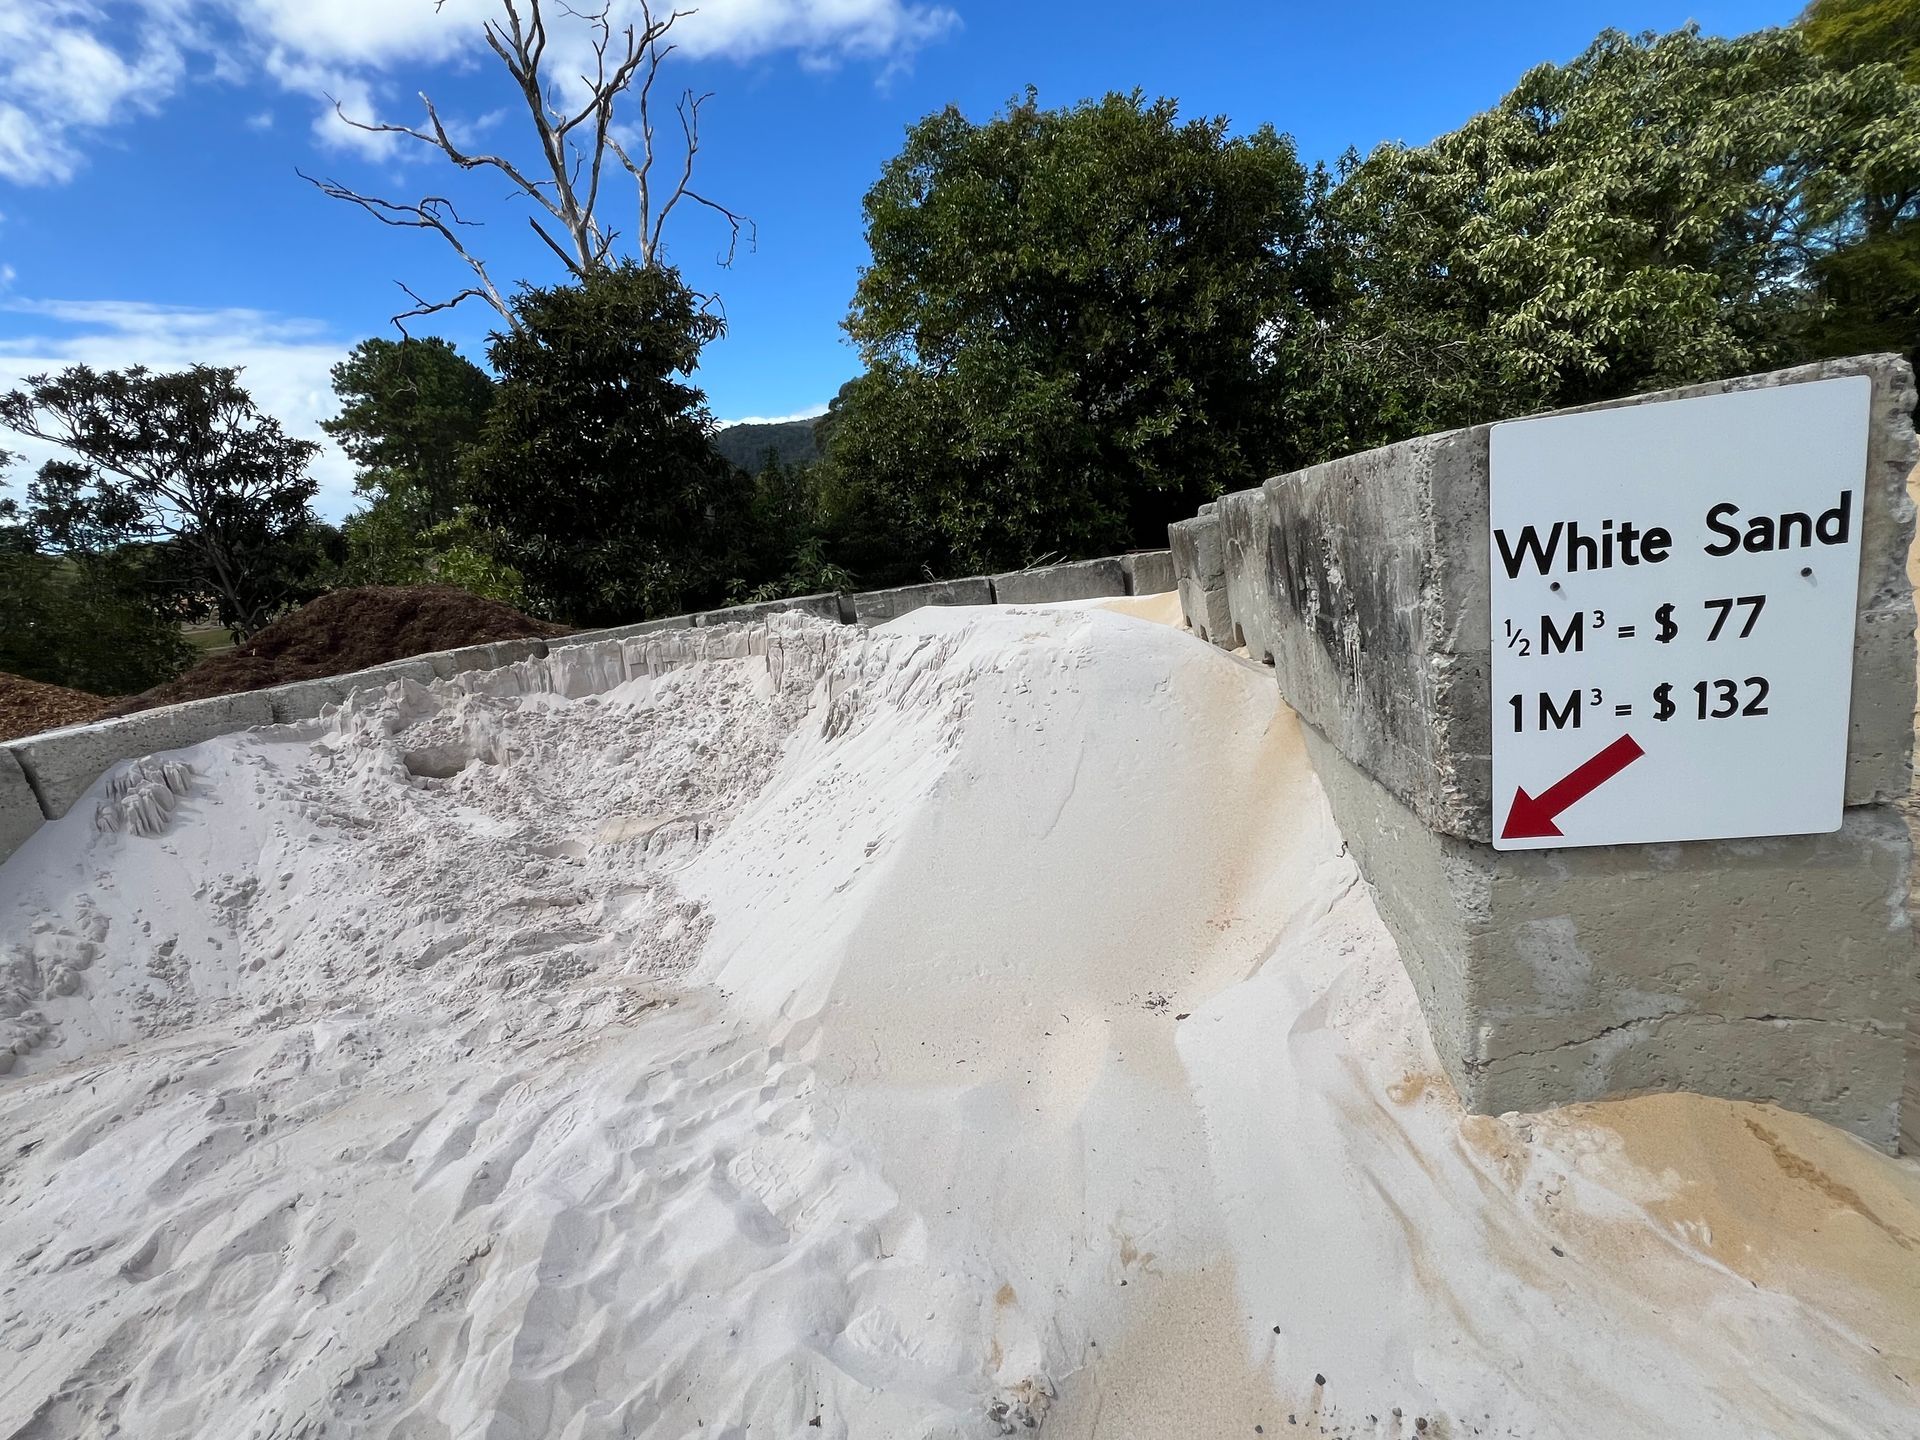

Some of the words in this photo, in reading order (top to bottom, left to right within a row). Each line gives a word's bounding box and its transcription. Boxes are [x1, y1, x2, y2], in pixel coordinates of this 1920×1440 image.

[1493, 519, 1673, 580] White
[1703, 489, 1853, 557] Sand
[1704, 594, 1767, 642] 77
